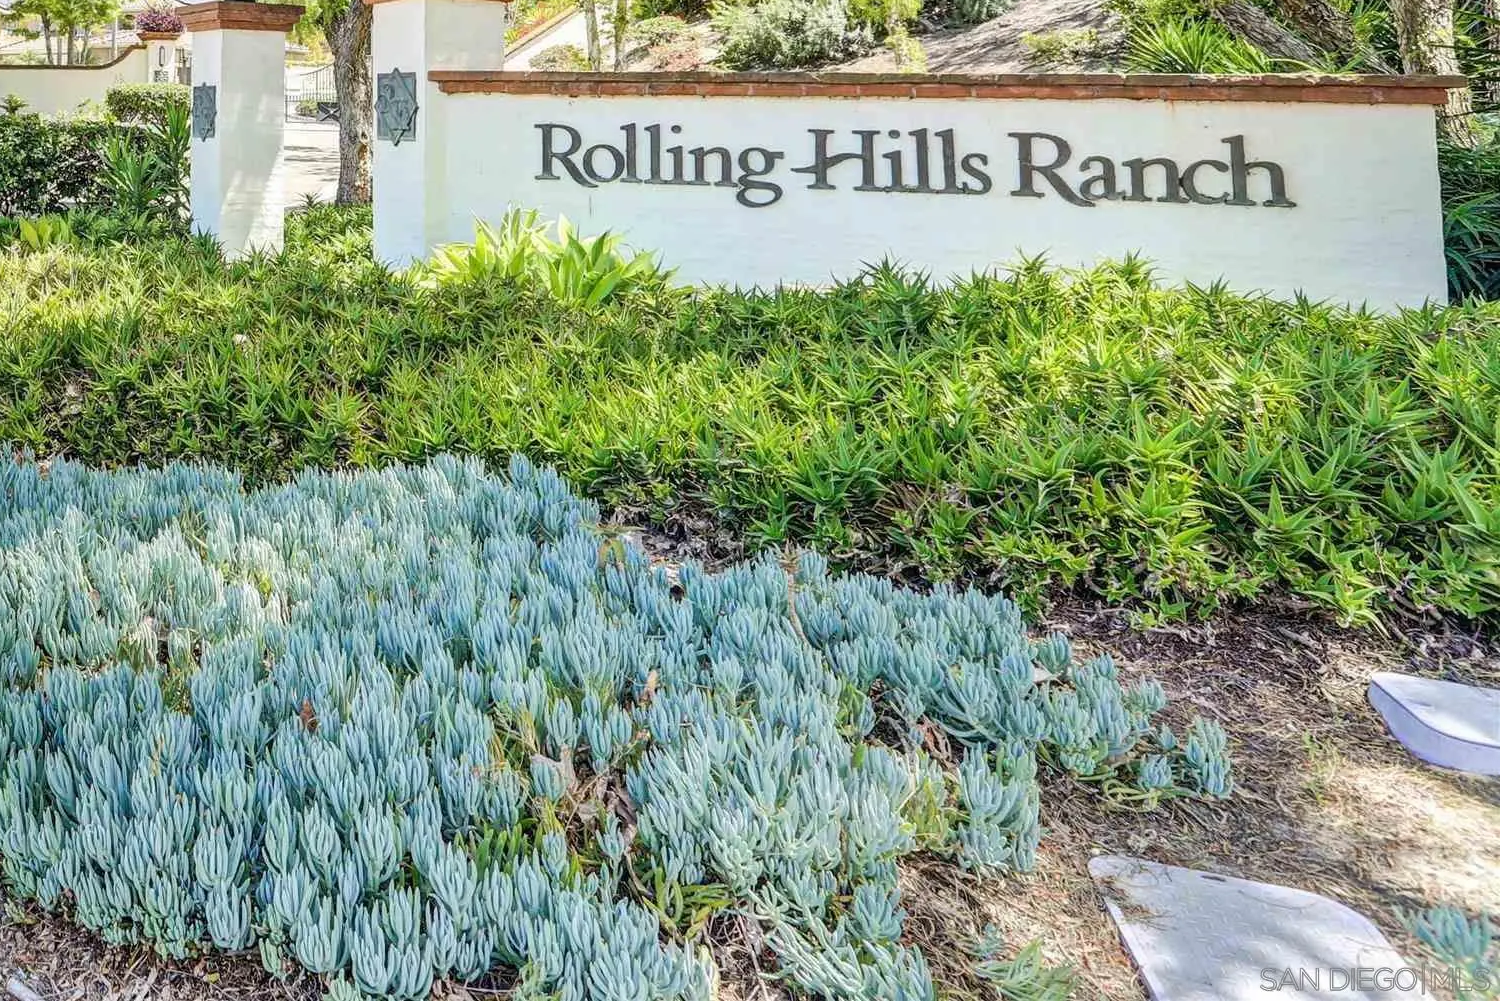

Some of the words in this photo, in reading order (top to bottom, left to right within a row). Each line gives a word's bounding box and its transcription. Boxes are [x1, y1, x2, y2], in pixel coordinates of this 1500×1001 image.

[534, 122, 784, 208] Rolling
[791, 128, 992, 194] Hills
[1008, 131, 1297, 208] Ranch
